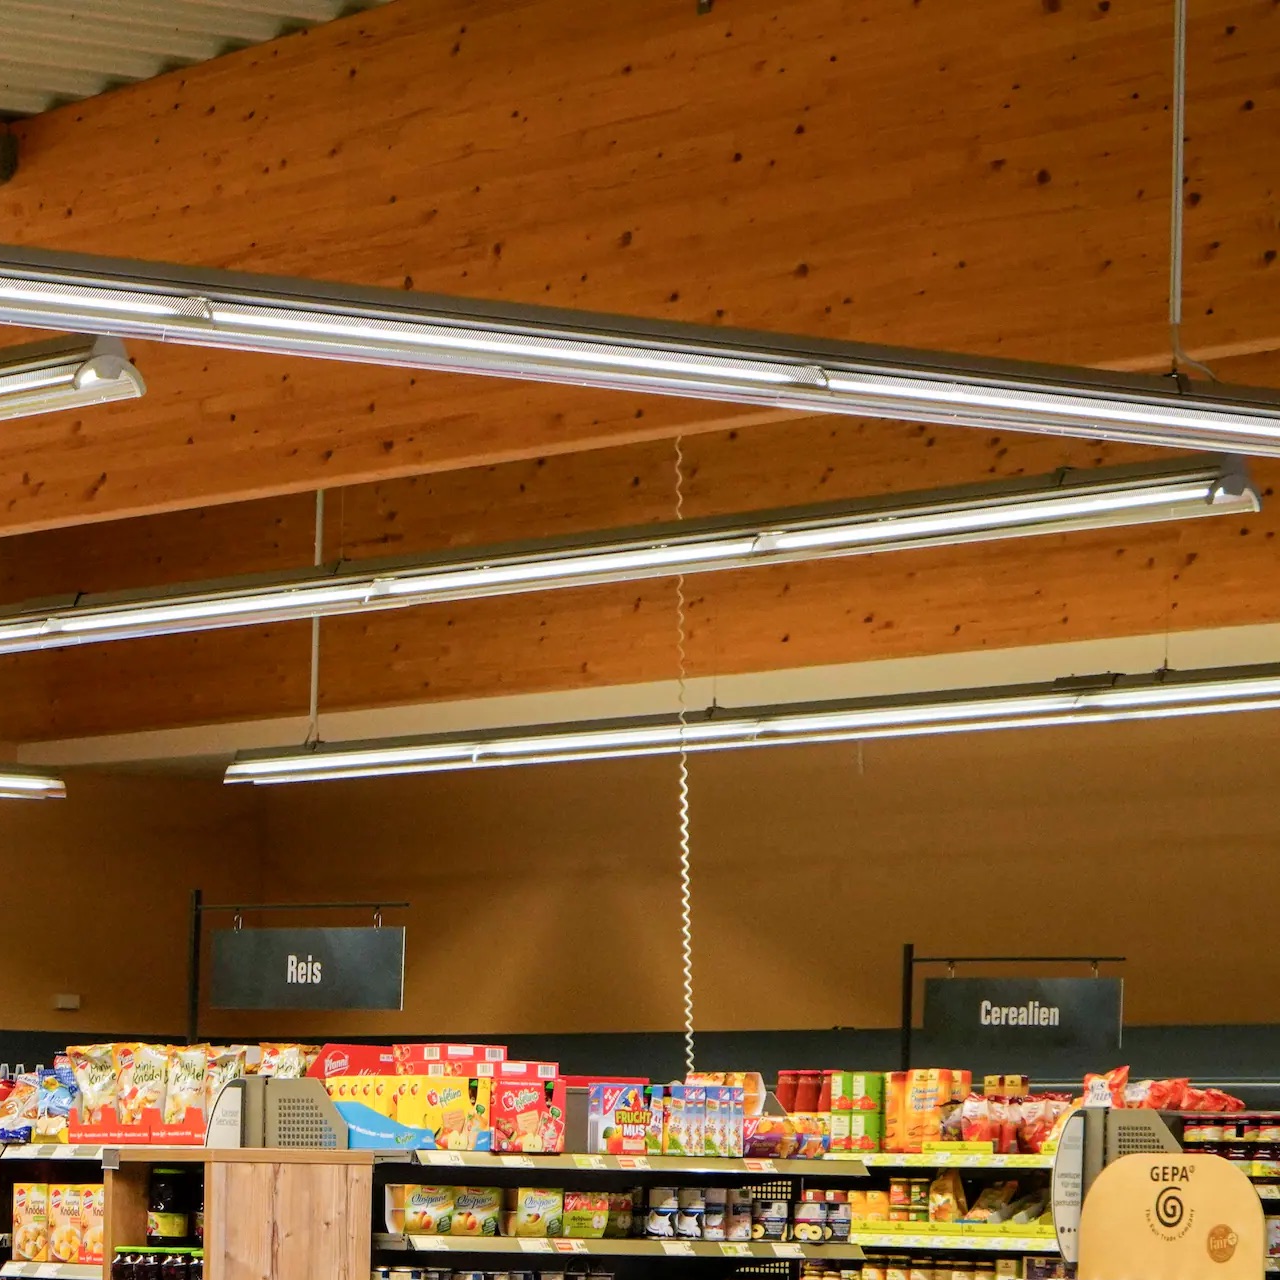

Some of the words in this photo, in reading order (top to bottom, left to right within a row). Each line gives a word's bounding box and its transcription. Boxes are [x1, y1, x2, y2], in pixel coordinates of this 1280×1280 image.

[286, 954, 322, 986] Reis
[980, 1000, 1061, 1028] Cerealien
[324, 1056, 349, 1074] Pfanni
[614, 1111, 652, 1124] FRUCHT
[623, 1123, 646, 1137] MUS
[1150, 1165, 1189, 1182] GEPA
[25, 1206, 46, 1216] Knödel
[60, 1207, 80, 1217] Knödel
[1159, 1233, 1178, 1243] Trade
[1177, 1207, 1197, 1240] Company
